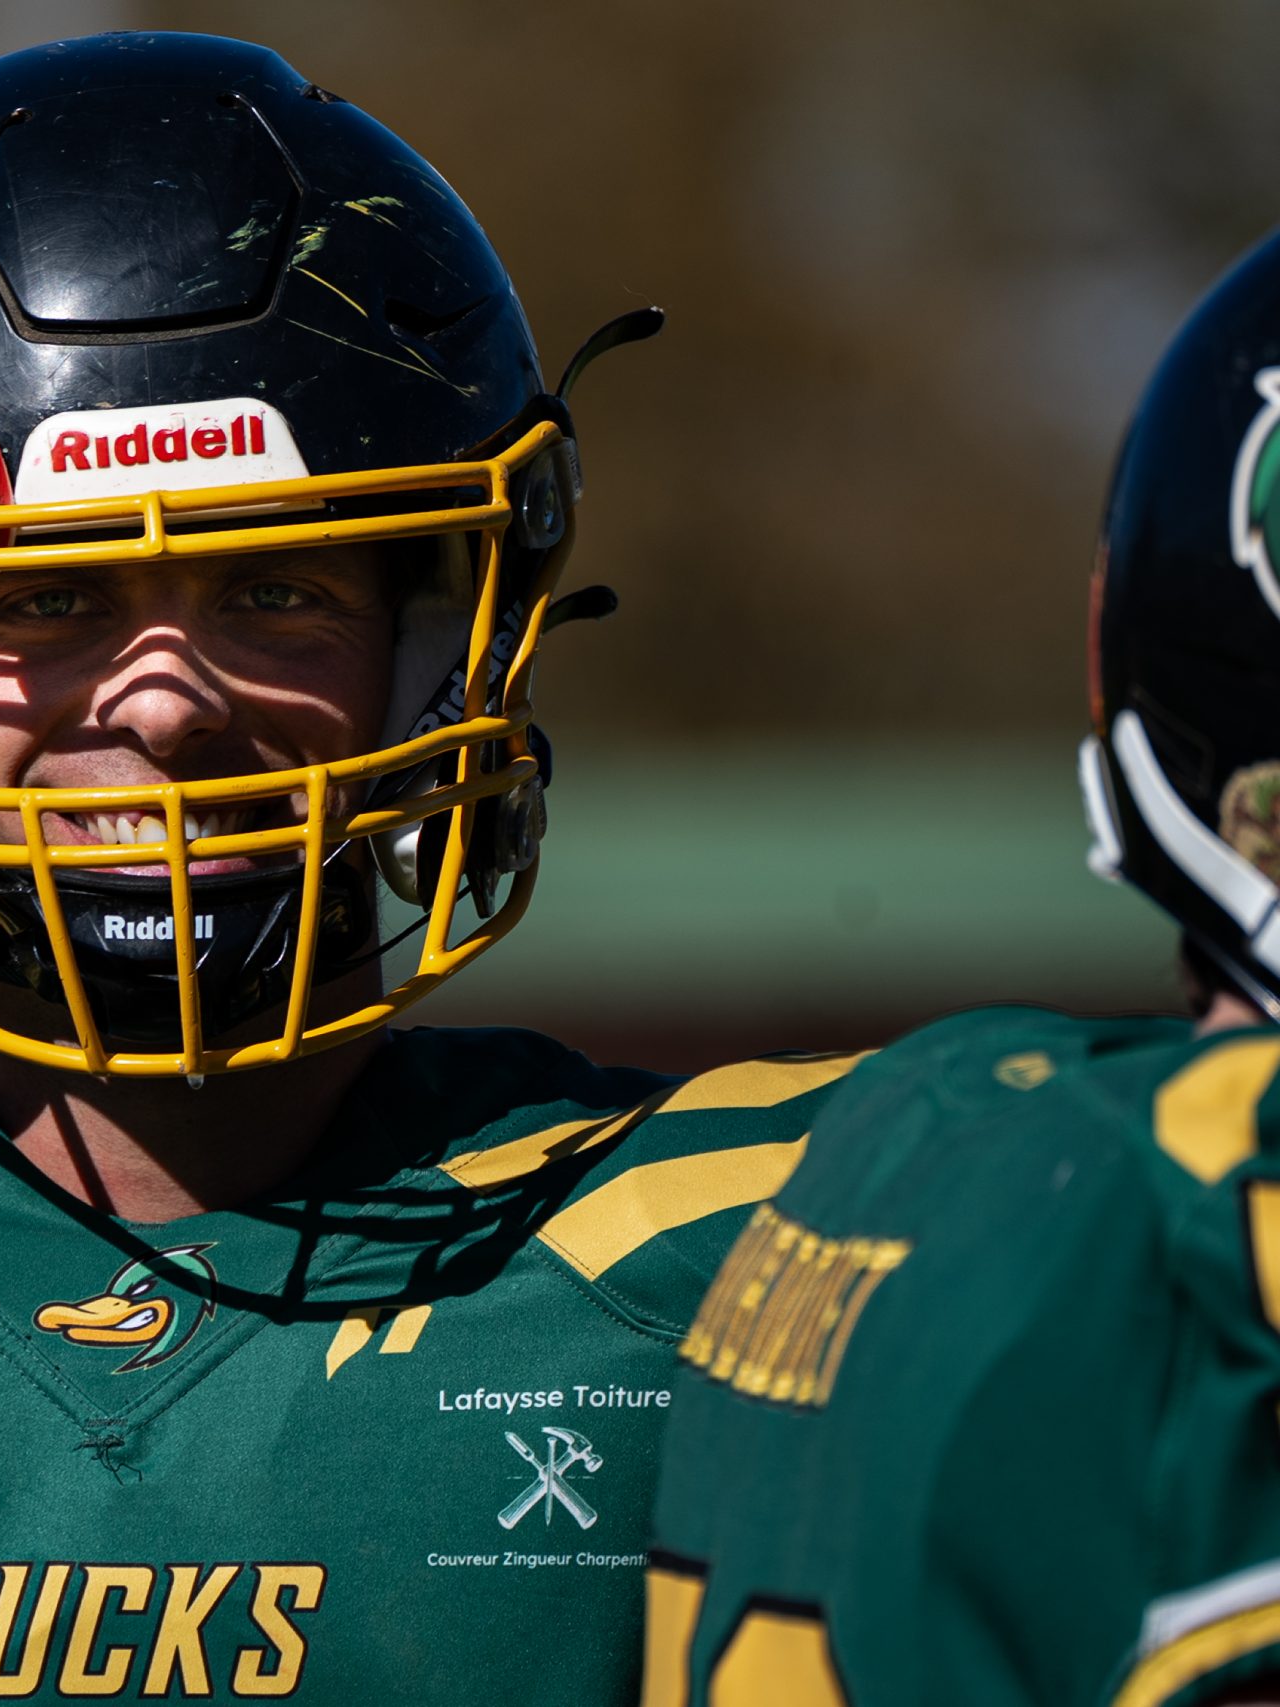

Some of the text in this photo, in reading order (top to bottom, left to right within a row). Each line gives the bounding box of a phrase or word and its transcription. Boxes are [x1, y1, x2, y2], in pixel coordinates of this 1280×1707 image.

[50, 411, 267, 472] Riddell
[104, 914, 214, 940] Riddll
[439, 1384, 671, 1414] Lafaysse Toiture
[427, 1552, 498, 1567] Couvreur
[503, 1552, 573, 1567] Zingueur
